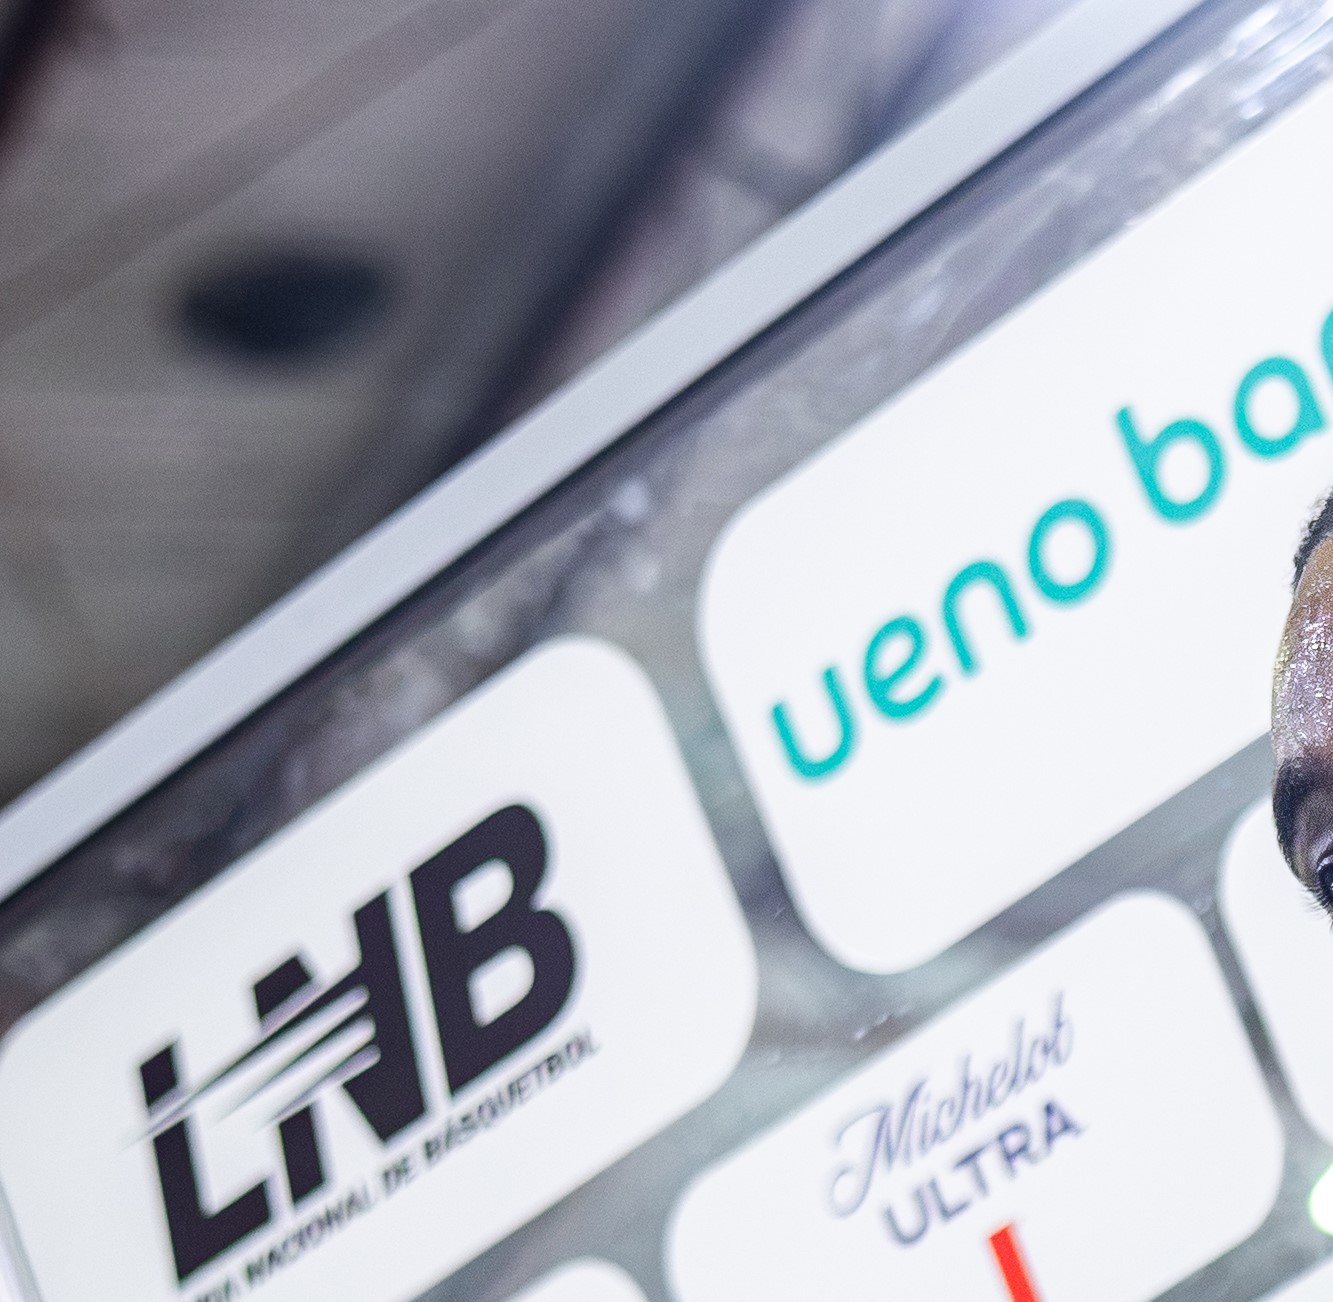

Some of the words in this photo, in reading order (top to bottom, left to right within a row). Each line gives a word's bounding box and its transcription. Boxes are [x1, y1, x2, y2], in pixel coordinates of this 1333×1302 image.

[771, 498, 1113, 783] ueno
[122, 803, 578, 1285] LNB
[884, 1099, 1084, 1247] ULTRA
